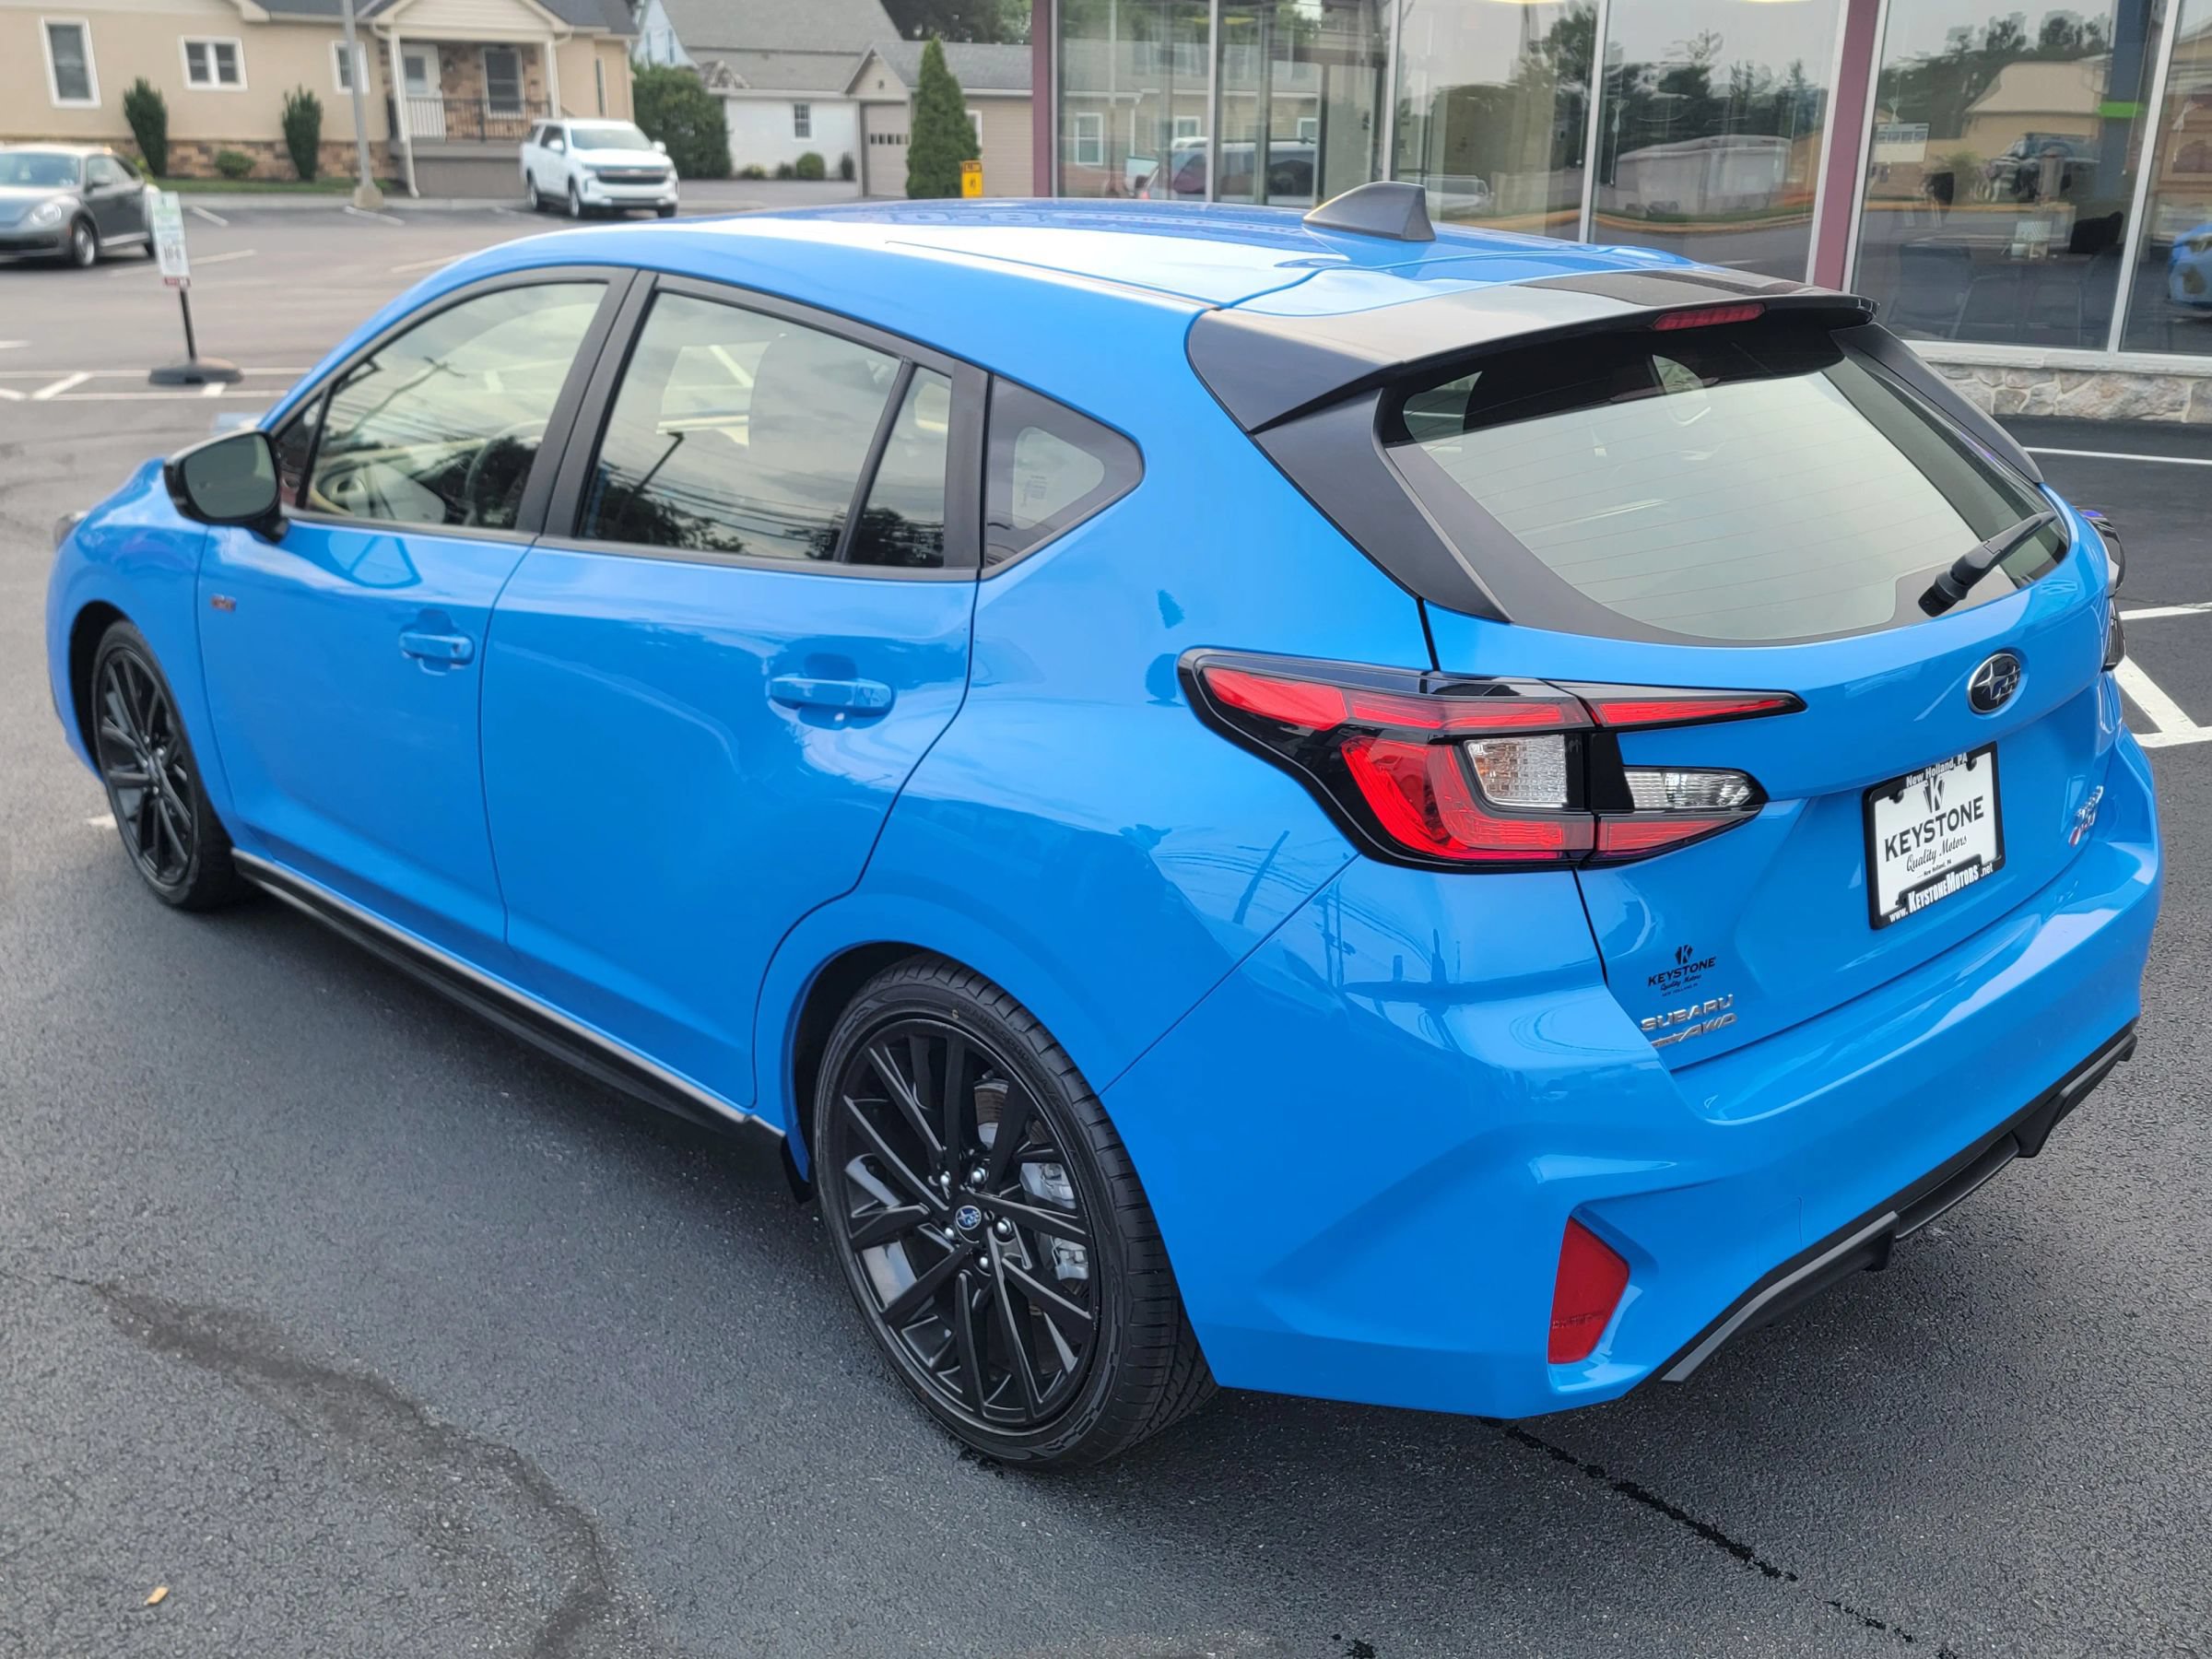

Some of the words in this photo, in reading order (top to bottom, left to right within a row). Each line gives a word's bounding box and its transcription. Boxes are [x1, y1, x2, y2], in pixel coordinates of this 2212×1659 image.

[1906, 772, 1924, 788] New
[1957, 752, 1969, 766] PA
[1884, 795, 1984, 863] KEYSTONE
[1906, 848, 1937, 873] Quality
[1938, 835, 1968, 857] Motors
[1648, 956, 1717, 987] KEYSTONE
[1641, 994, 1734, 1031] SUBARU
